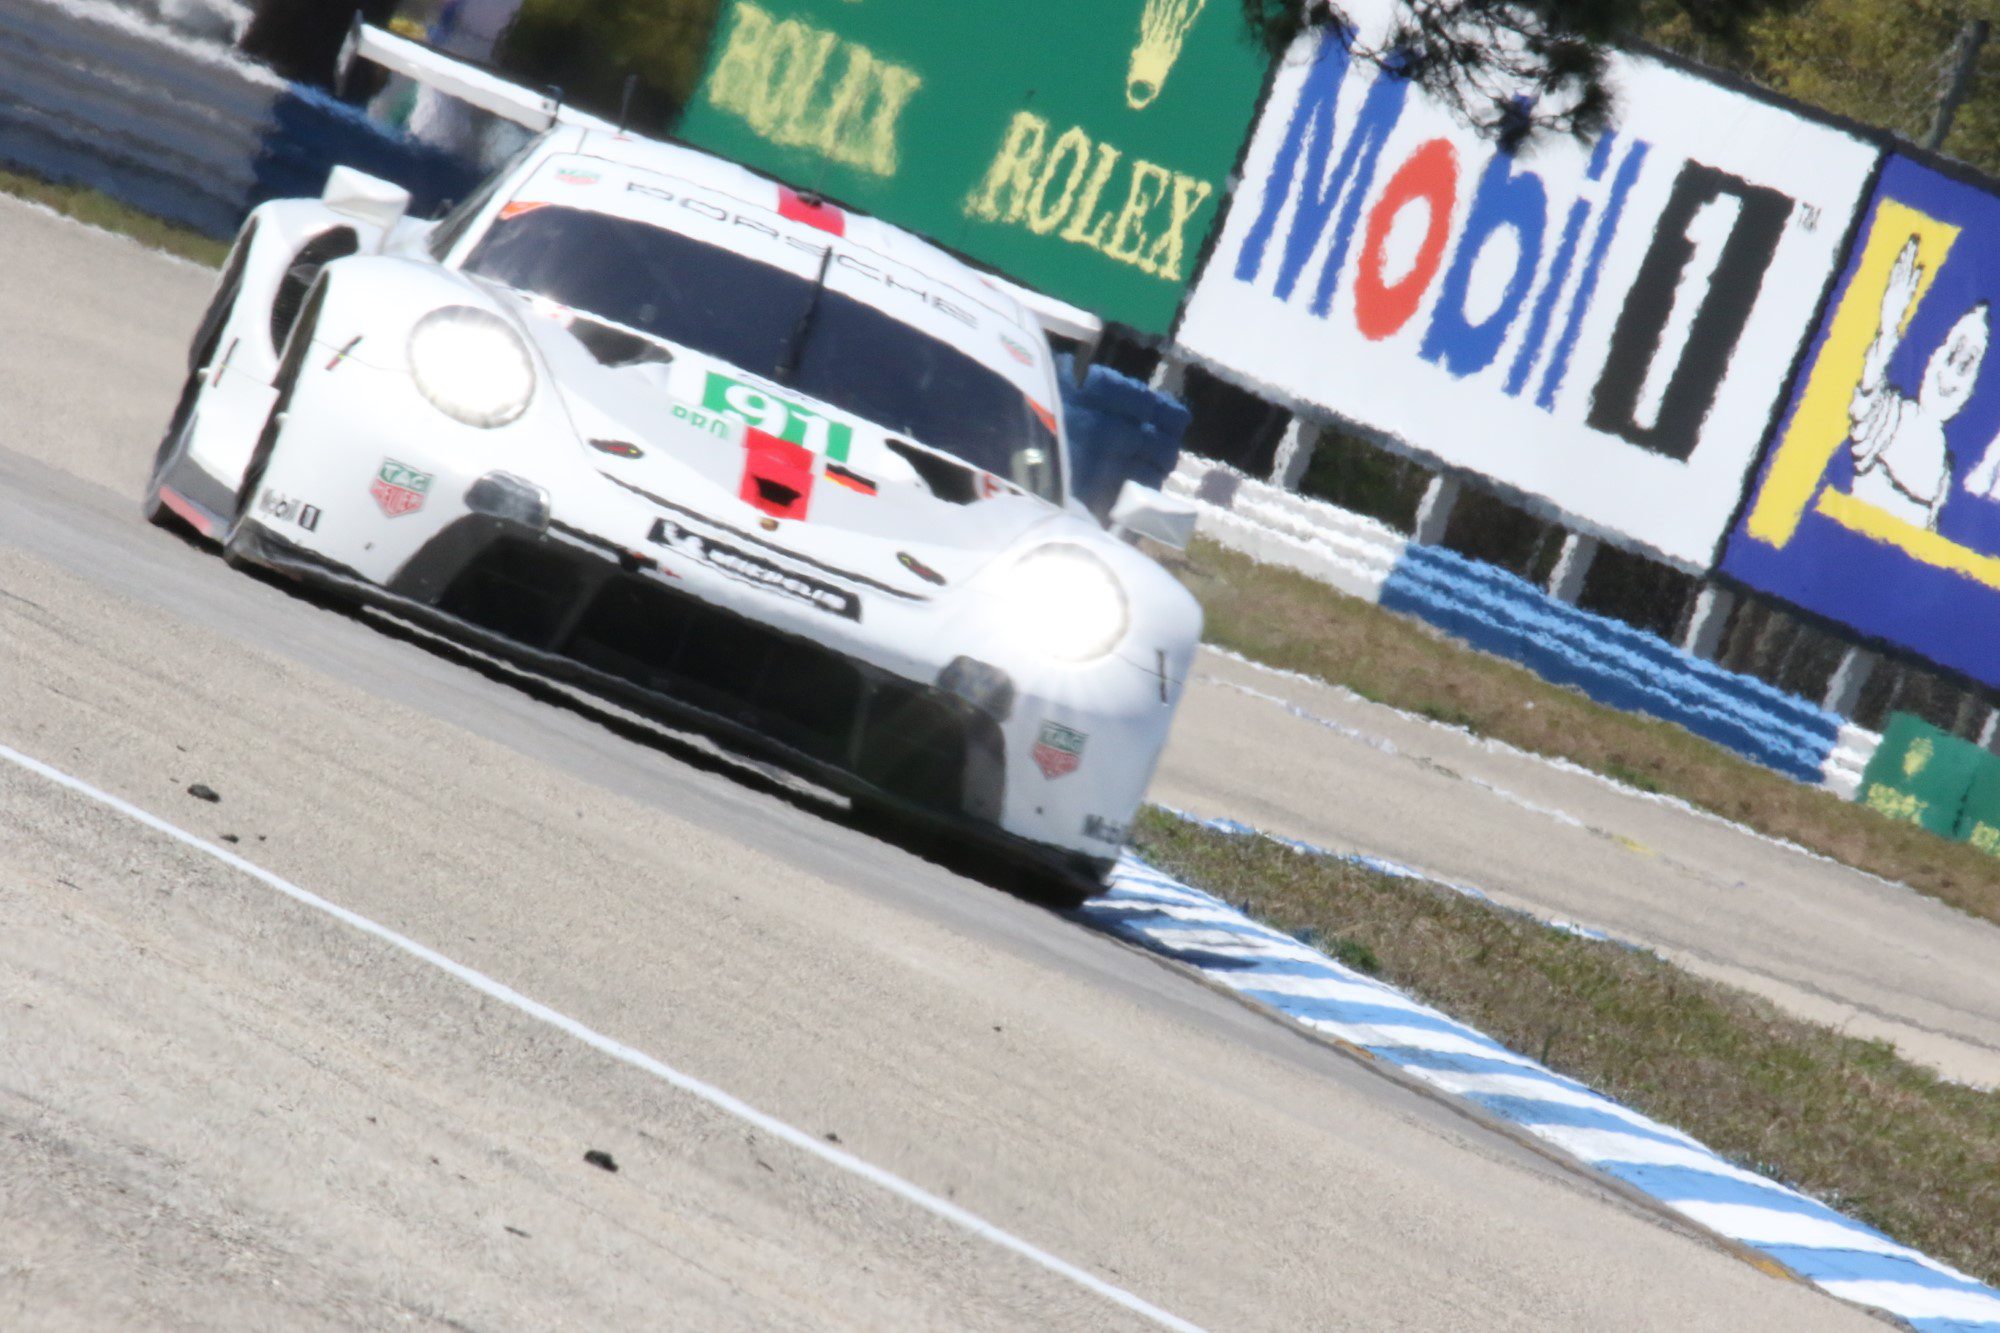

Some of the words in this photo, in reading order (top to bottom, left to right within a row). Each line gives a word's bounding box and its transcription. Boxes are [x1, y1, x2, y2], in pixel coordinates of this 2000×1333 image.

[626, 181, 980, 330] PORSCHE
[963, 110, 1212, 281] ROLEX
[1234, 22, 1652, 414] Mobil
[384, 464, 428, 490] TAG
[721, 384, 830, 456] 91
